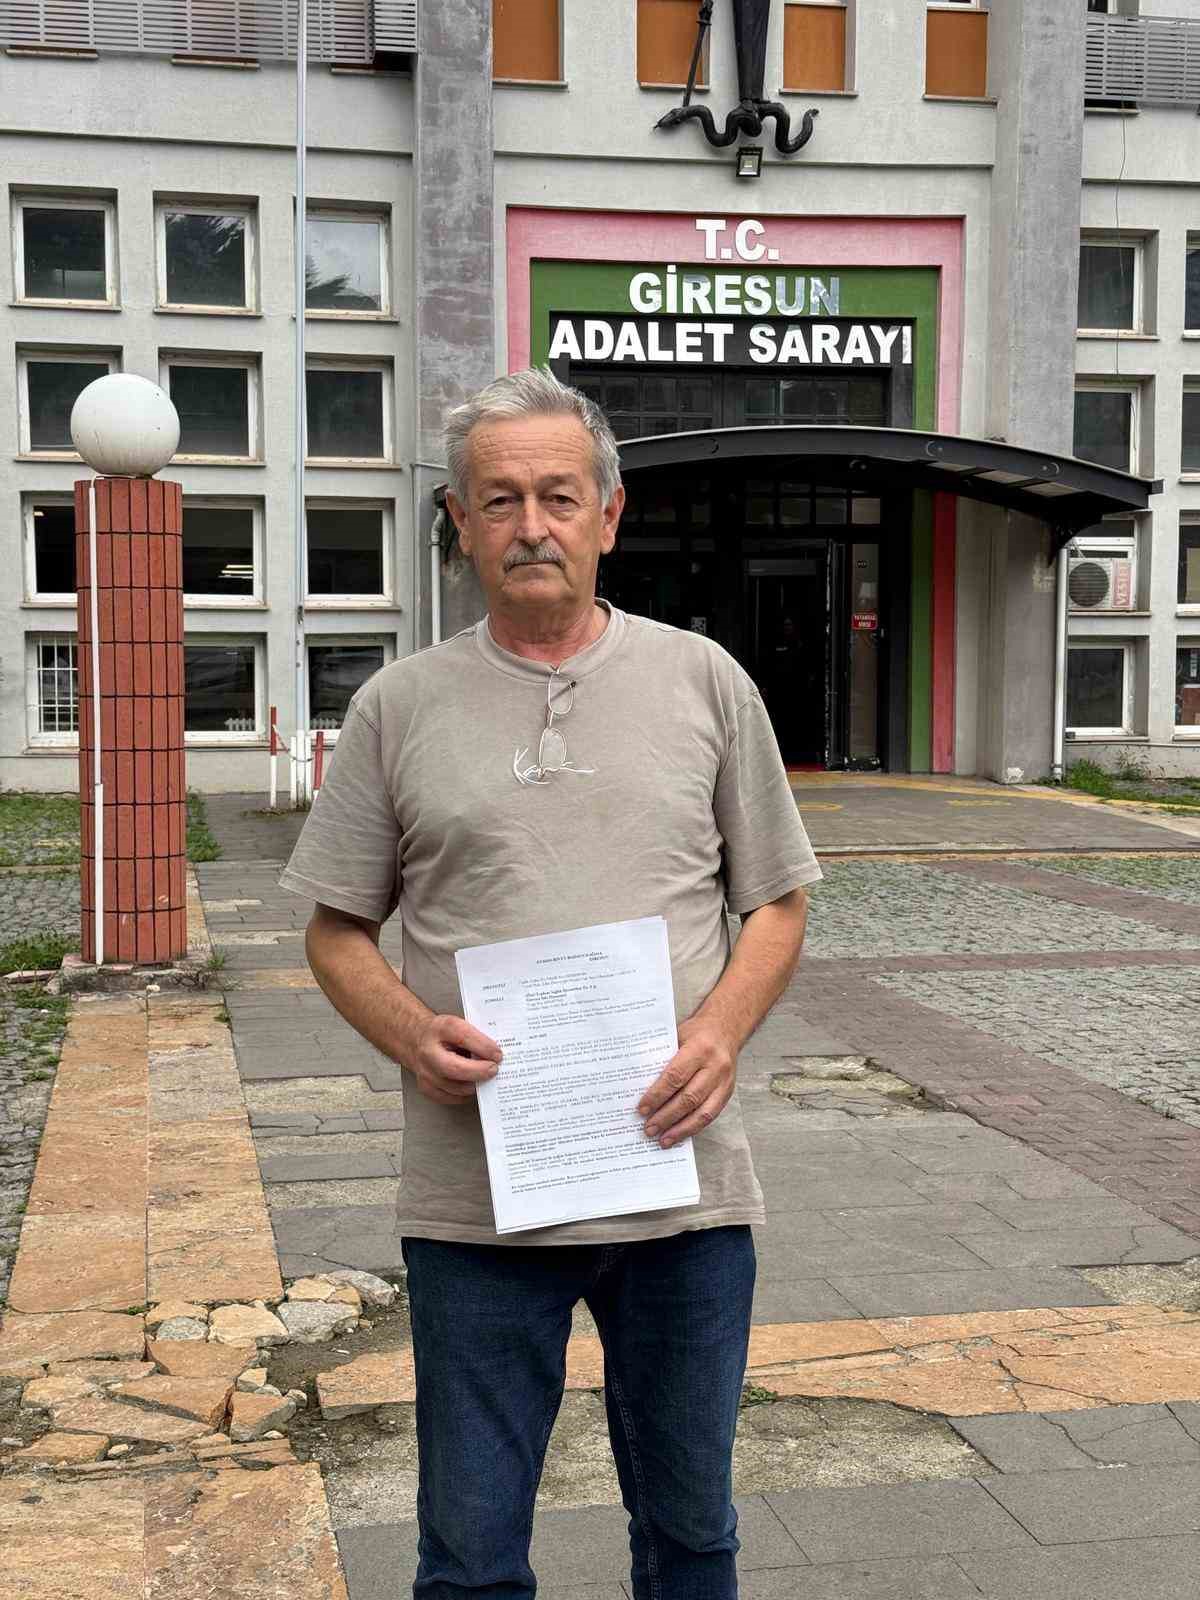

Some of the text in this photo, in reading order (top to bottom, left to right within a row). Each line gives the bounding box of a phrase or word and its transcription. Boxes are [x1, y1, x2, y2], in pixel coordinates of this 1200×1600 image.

[696, 219, 780, 261] T.C.
[629, 264, 840, 316] GİRESUN
[549, 319, 913, 365] ADALET SARAYI
